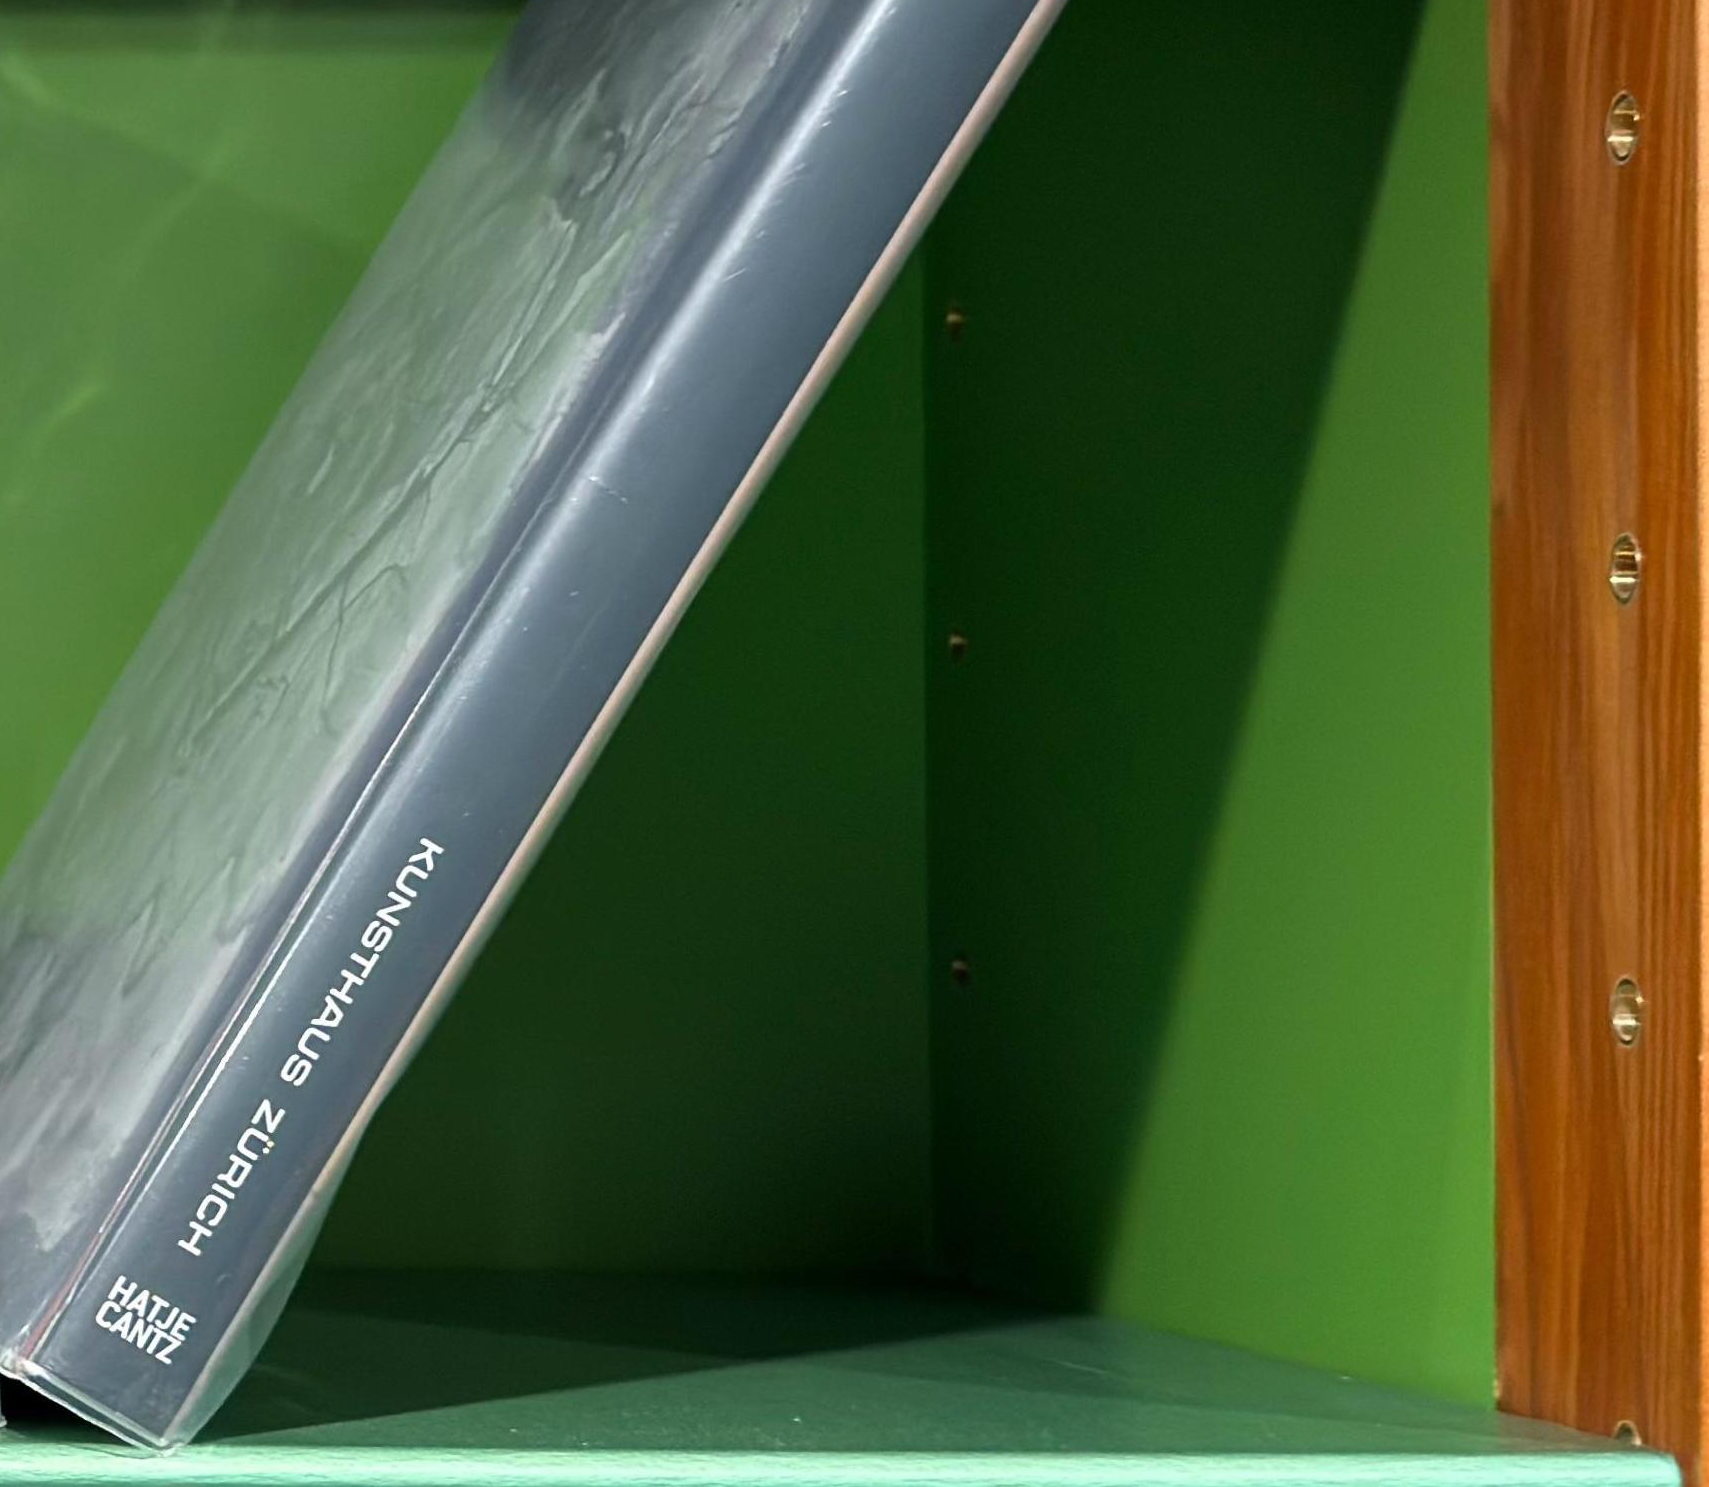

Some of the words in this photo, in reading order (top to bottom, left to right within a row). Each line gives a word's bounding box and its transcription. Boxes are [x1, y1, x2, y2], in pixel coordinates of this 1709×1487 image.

[281, 838, 444, 1087] KUNSTHAUS
[178, 1099, 284, 1256] ZÜRICH
[95, 1300, 180, 1364] CANTZ
[108, 1276, 195, 1342] HATJE
